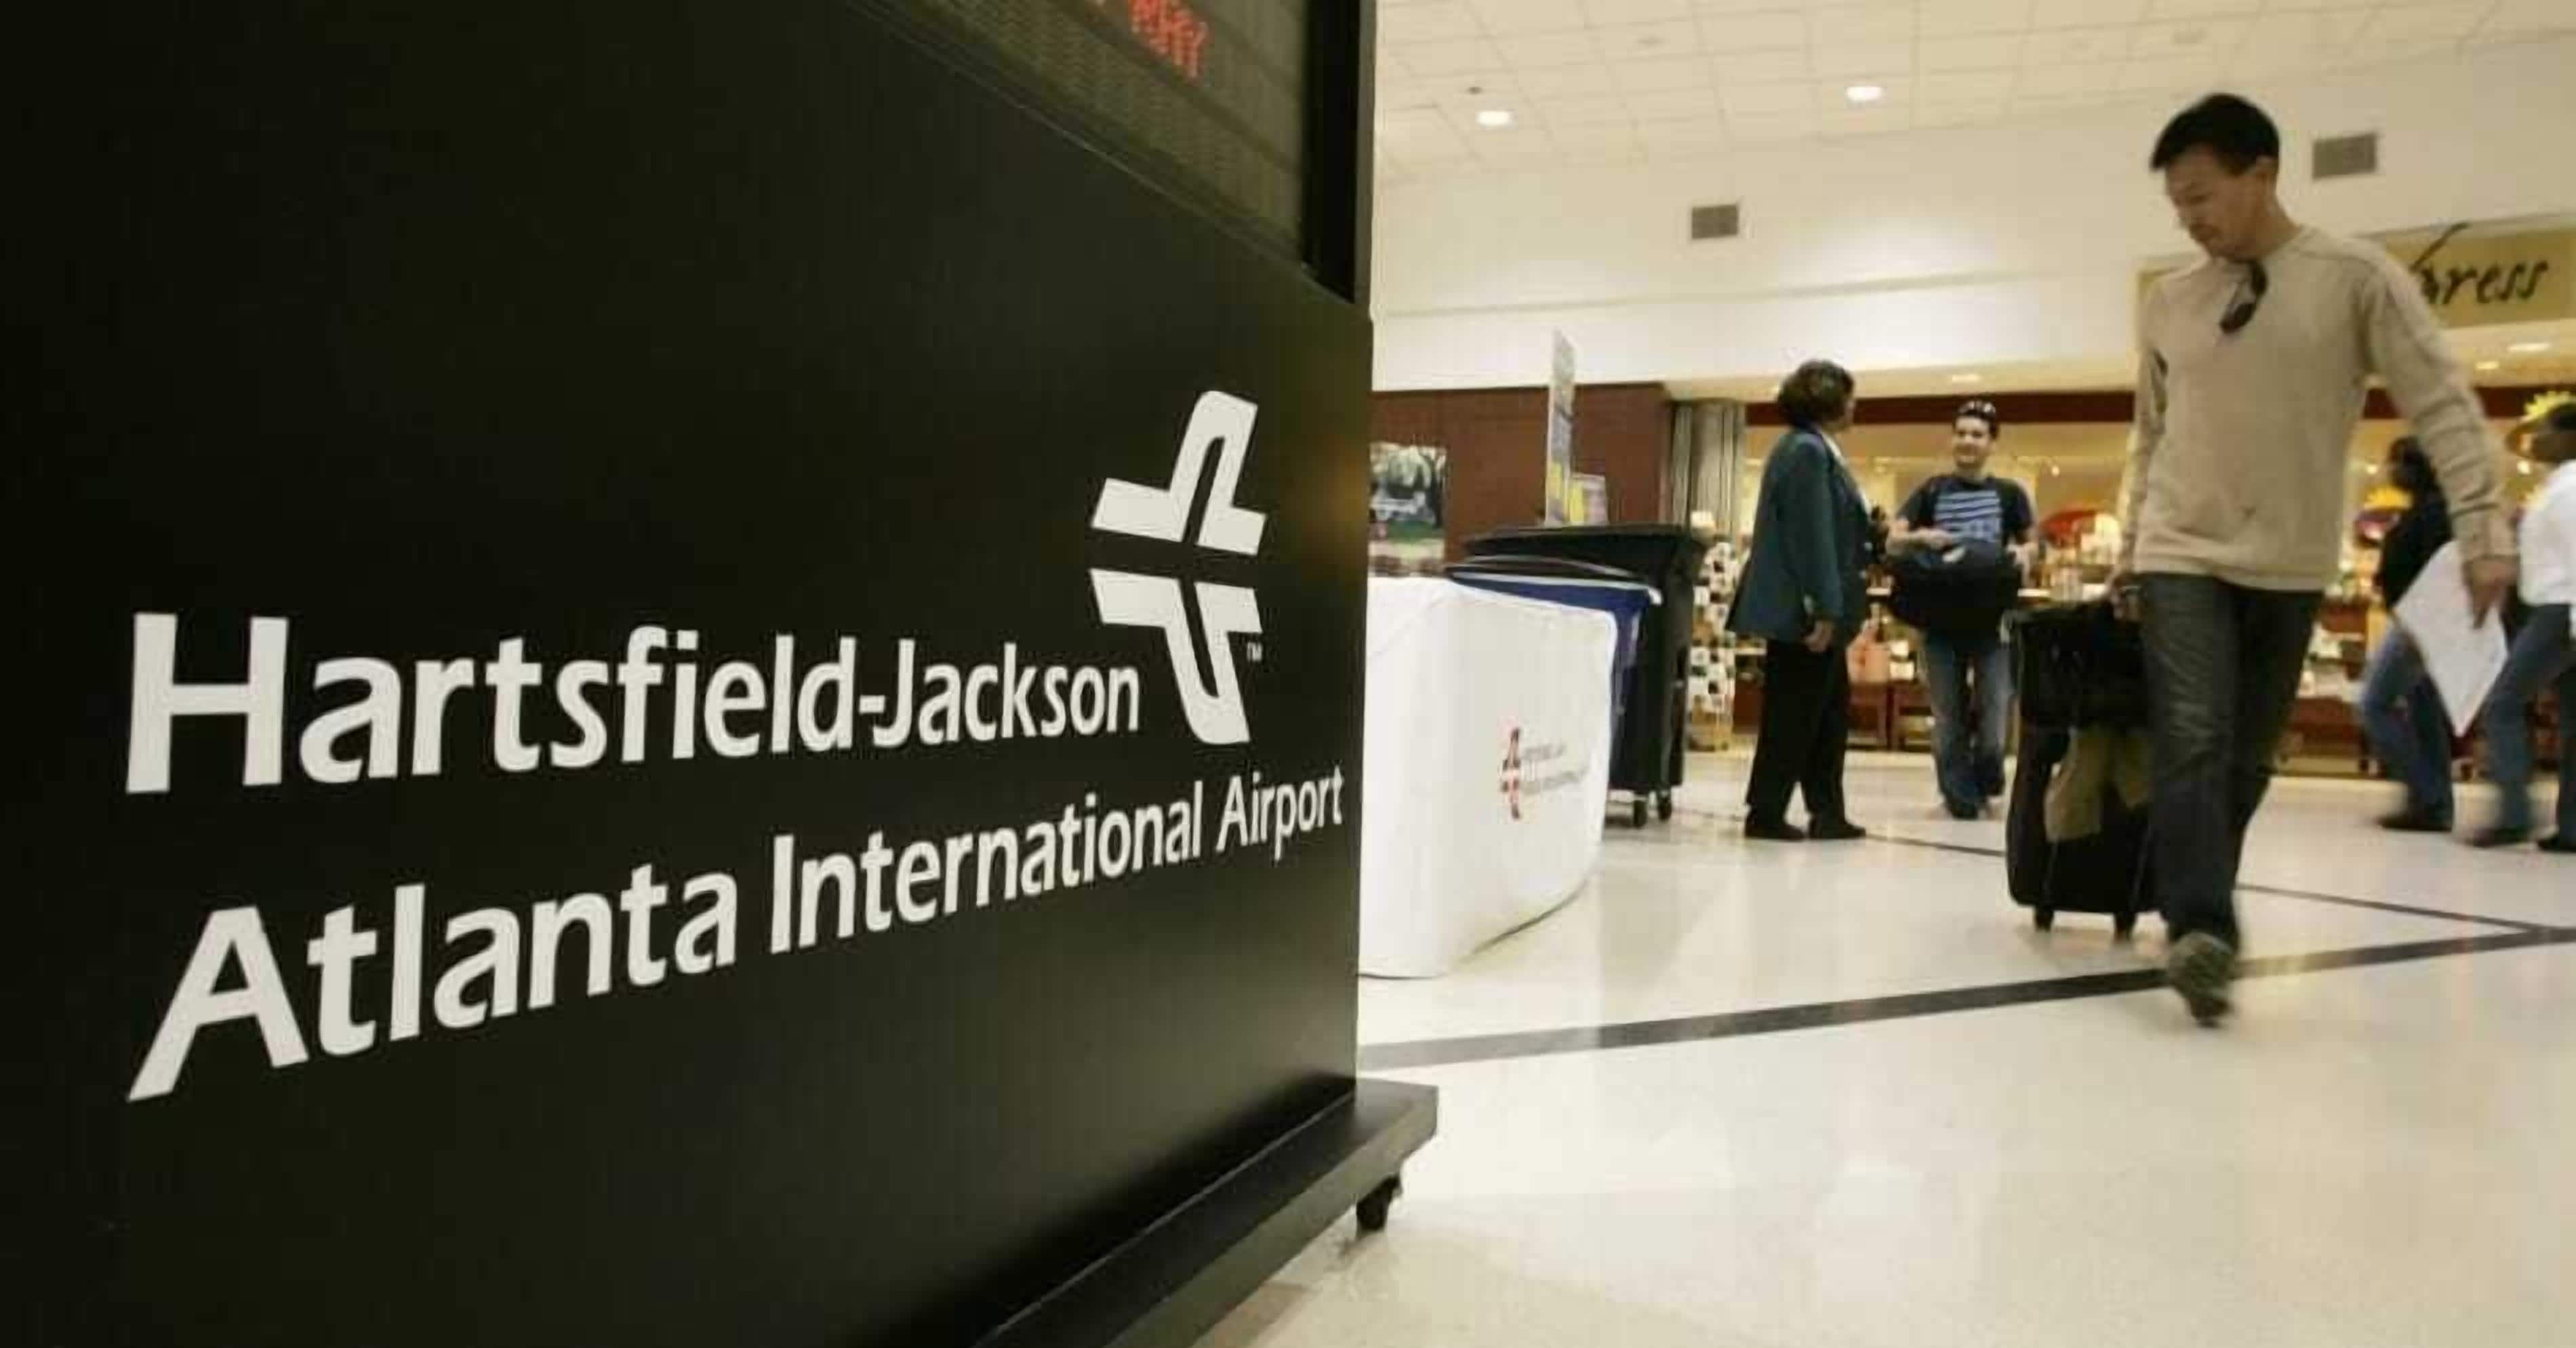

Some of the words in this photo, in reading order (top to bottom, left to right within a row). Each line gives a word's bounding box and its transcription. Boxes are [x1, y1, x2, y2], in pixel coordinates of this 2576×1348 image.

[126, 613, 1140, 793] Hartsfield-Jackson
[129, 864, 738, 1101] Atlanta
[770, 780, 1204, 954] International
[1215, 765, 1345, 861] Airport
